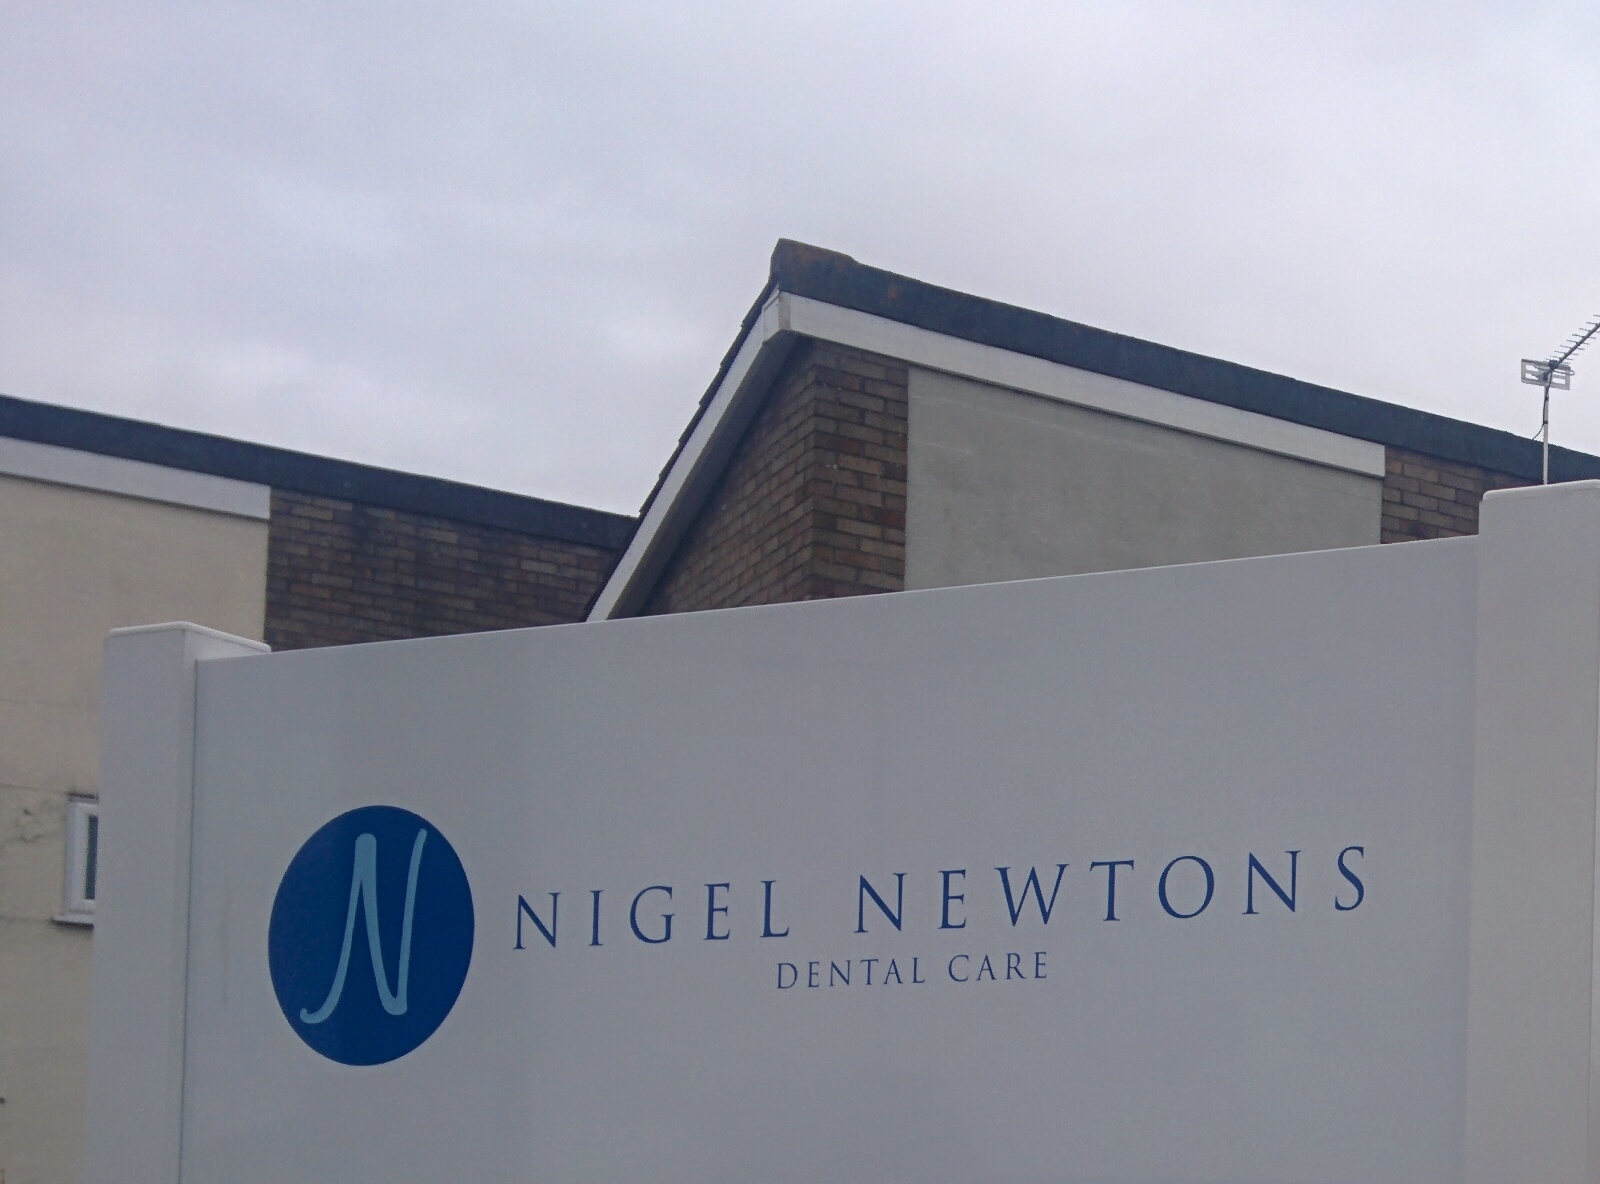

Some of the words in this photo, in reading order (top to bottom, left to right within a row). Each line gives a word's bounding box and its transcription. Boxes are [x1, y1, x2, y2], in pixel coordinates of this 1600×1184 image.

[300, 828, 427, 1024] N
[513, 880, 789, 950] NIGEL
[854, 846, 1364, 933] NEWTONS
[777, 957, 925, 989] DENTAL
[949, 952, 1046, 982] CARE
